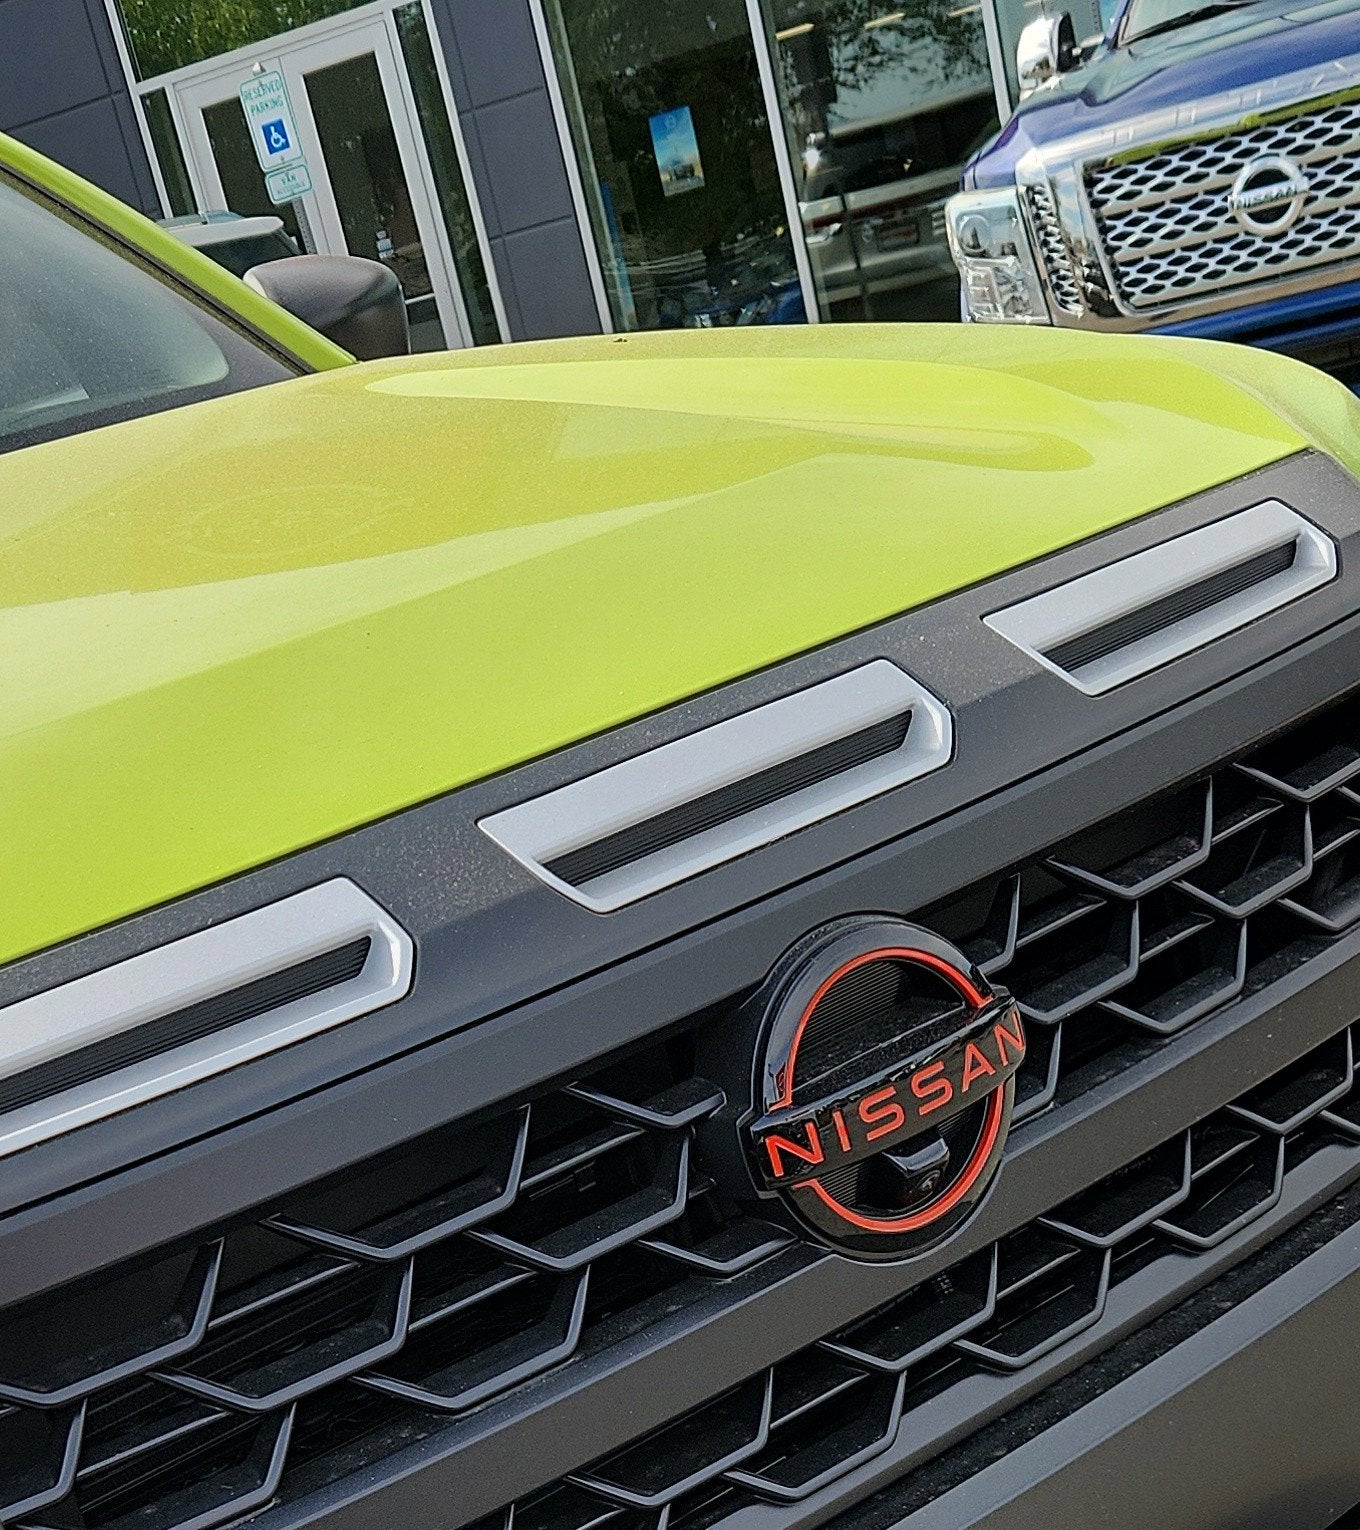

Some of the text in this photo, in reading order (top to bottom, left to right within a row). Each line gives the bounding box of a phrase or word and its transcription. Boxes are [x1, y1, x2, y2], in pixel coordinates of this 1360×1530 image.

[243, 80, 282, 100] RESERVED
[250, 95, 284, 116] PARKING
[764, 1009, 1026, 1178] NISSAN
